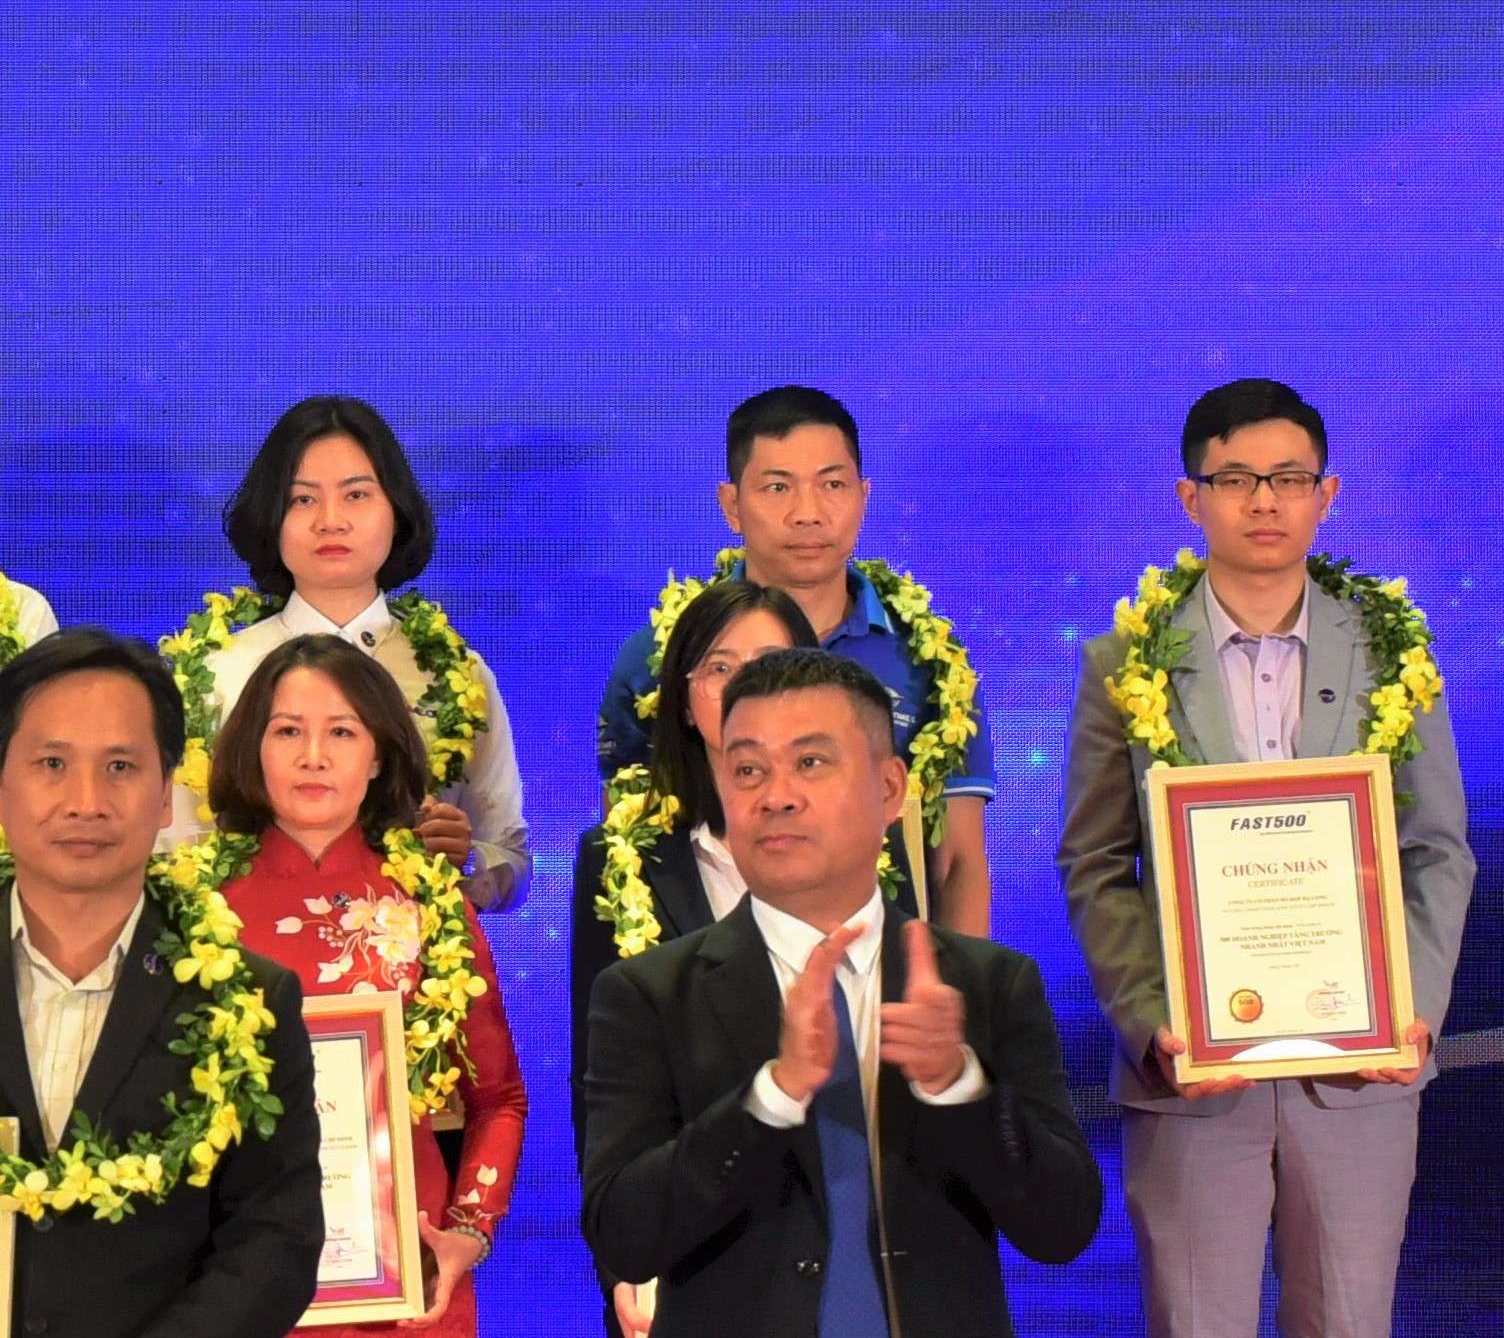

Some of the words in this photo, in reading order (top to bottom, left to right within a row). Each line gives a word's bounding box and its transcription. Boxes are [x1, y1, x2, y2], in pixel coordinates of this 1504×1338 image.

[1230, 814, 1307, 831] FAST500
[1222, 863, 1278, 878] CHỨNG
[1283, 859, 1328, 875] NHẬN
